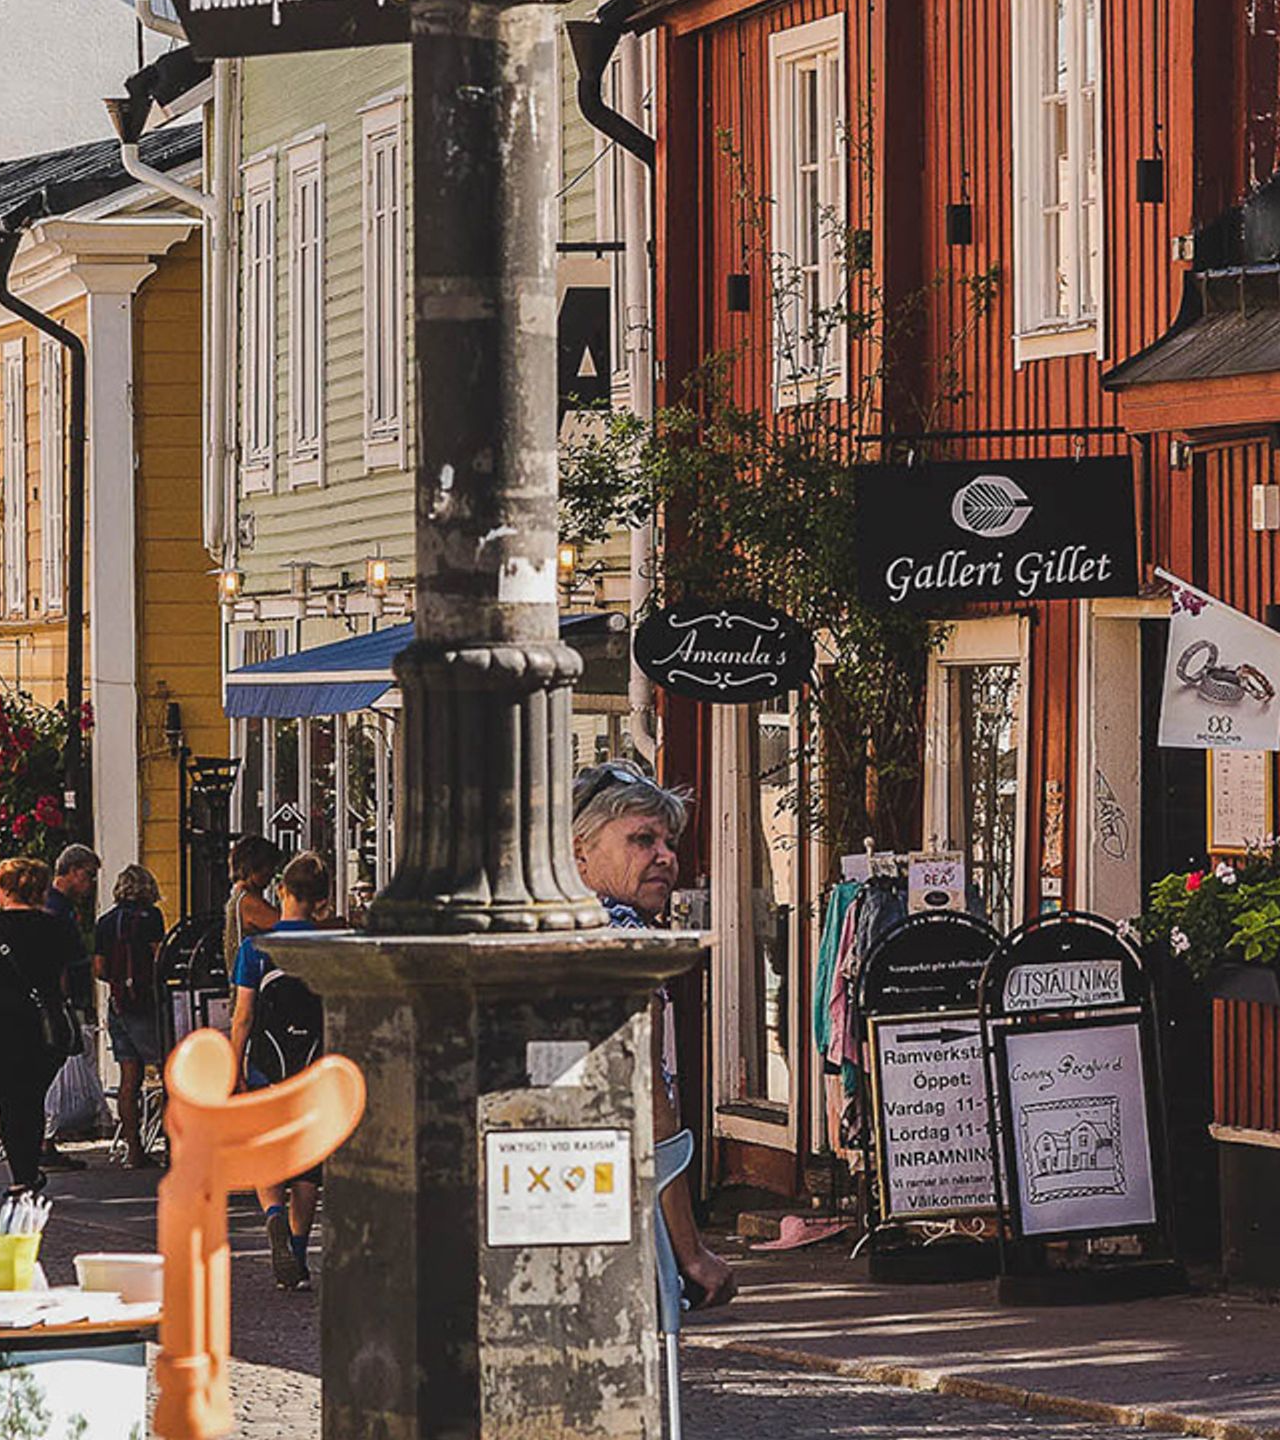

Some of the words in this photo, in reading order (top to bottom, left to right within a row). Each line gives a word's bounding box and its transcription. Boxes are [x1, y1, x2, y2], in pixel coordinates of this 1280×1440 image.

[886, 550, 1004, 602] Galleri
[1015, 545, 1111, 597] Gillet
[652, 629, 787, 665] Amanda's
[1008, 967, 1119, 998] UTSTÄLLNING
[884, 1047, 983, 1065] Ramverksta
[913, 1070, 972, 1091] Öppet:
[885, 1100, 945, 1117] Vardag
[890, 1126, 949, 1141] Lördag
